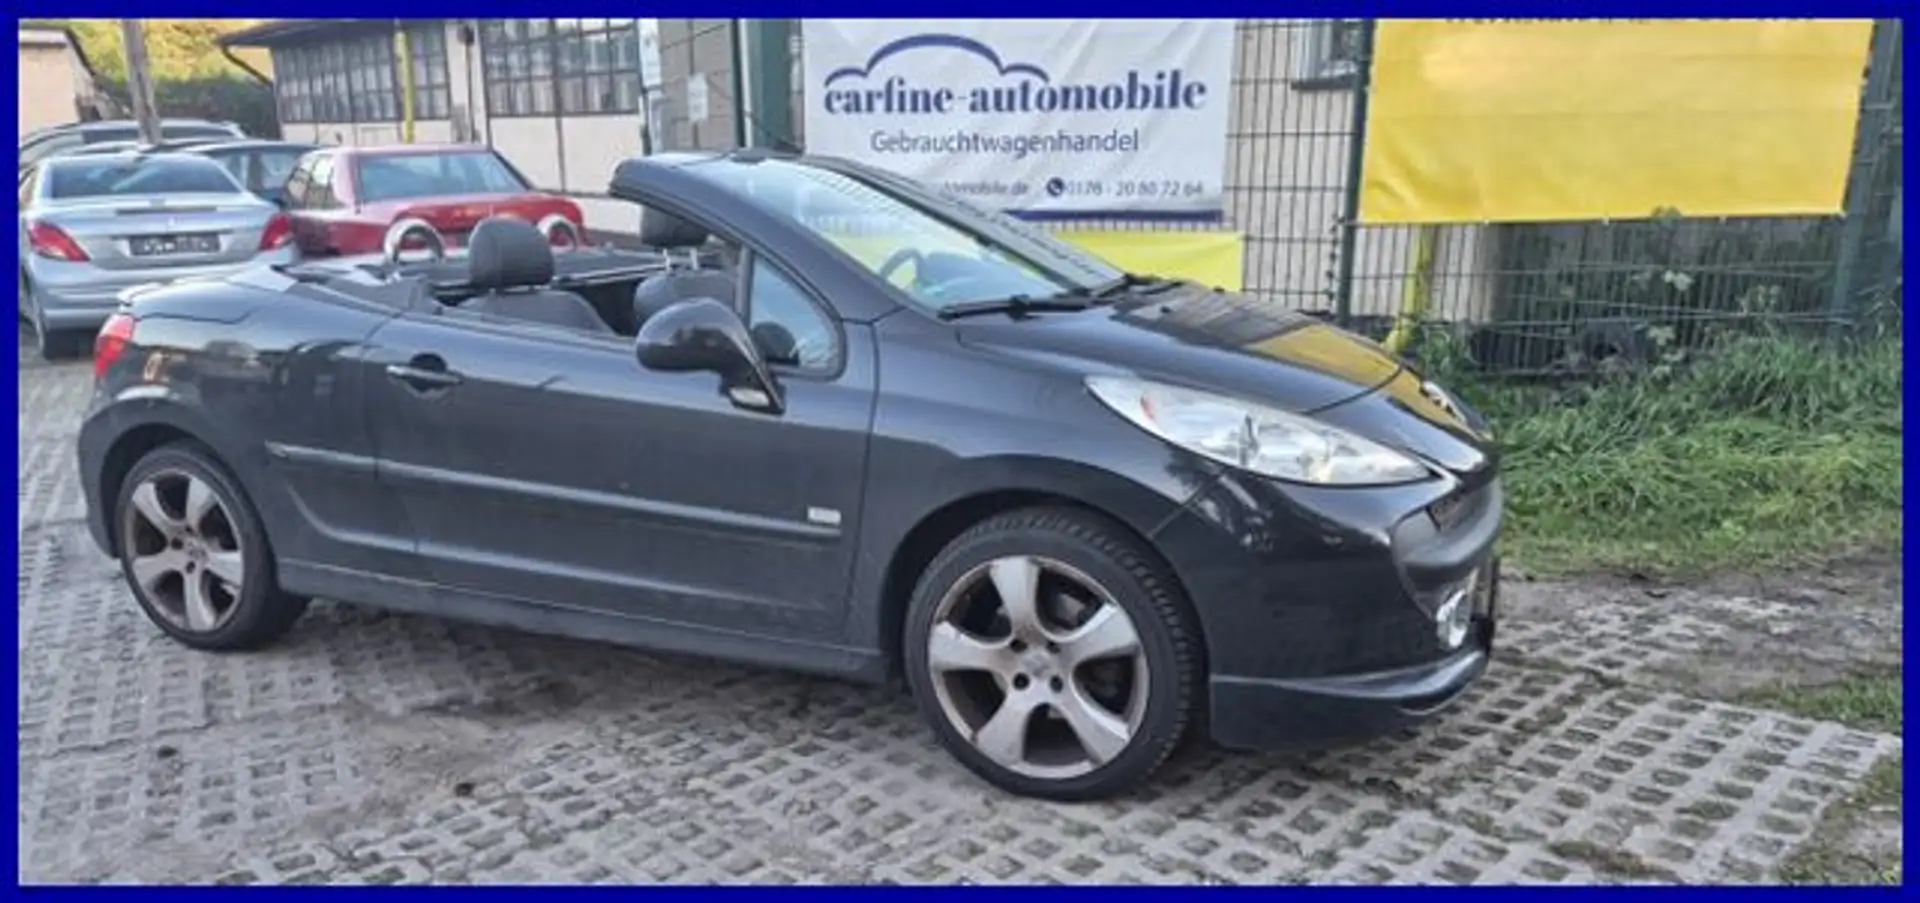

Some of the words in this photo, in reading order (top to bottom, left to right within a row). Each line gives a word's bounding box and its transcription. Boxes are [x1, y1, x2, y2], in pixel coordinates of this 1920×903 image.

[824, 70, 1207, 115] carfine-automobile
[870, 128, 1139, 160] Gebrauchtwagenhandel
[1115, 179, 1136, 197] 20
[1161, 179, 1181, 197] 72
